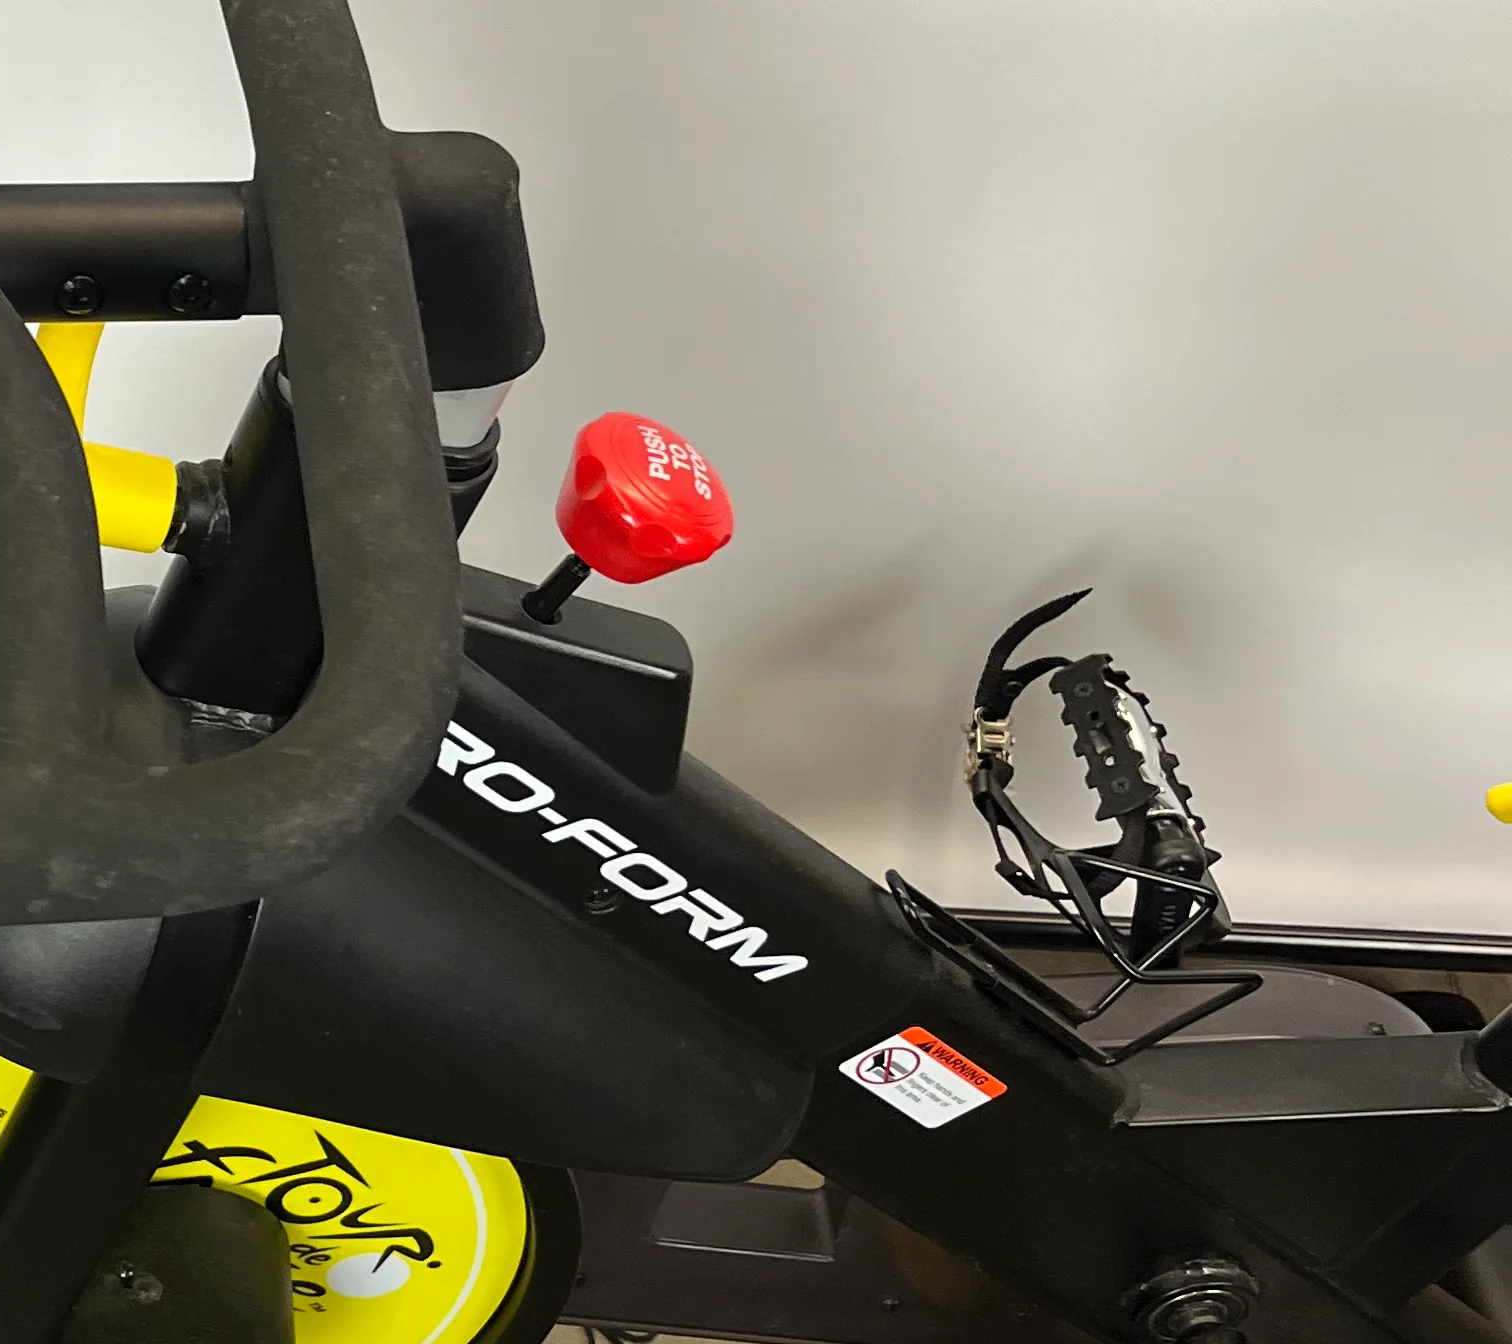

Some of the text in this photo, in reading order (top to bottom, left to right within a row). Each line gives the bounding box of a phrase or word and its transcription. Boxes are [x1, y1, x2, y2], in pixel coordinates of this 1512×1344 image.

[636, 425, 671, 481] PUSH
[669, 443, 691, 471] TO
[685, 443, 712, 501] STOP
[436, 720, 810, 983] RO-FORM
[932, 1045, 989, 1086] WARNING
[289, 1243, 340, 1266] de
